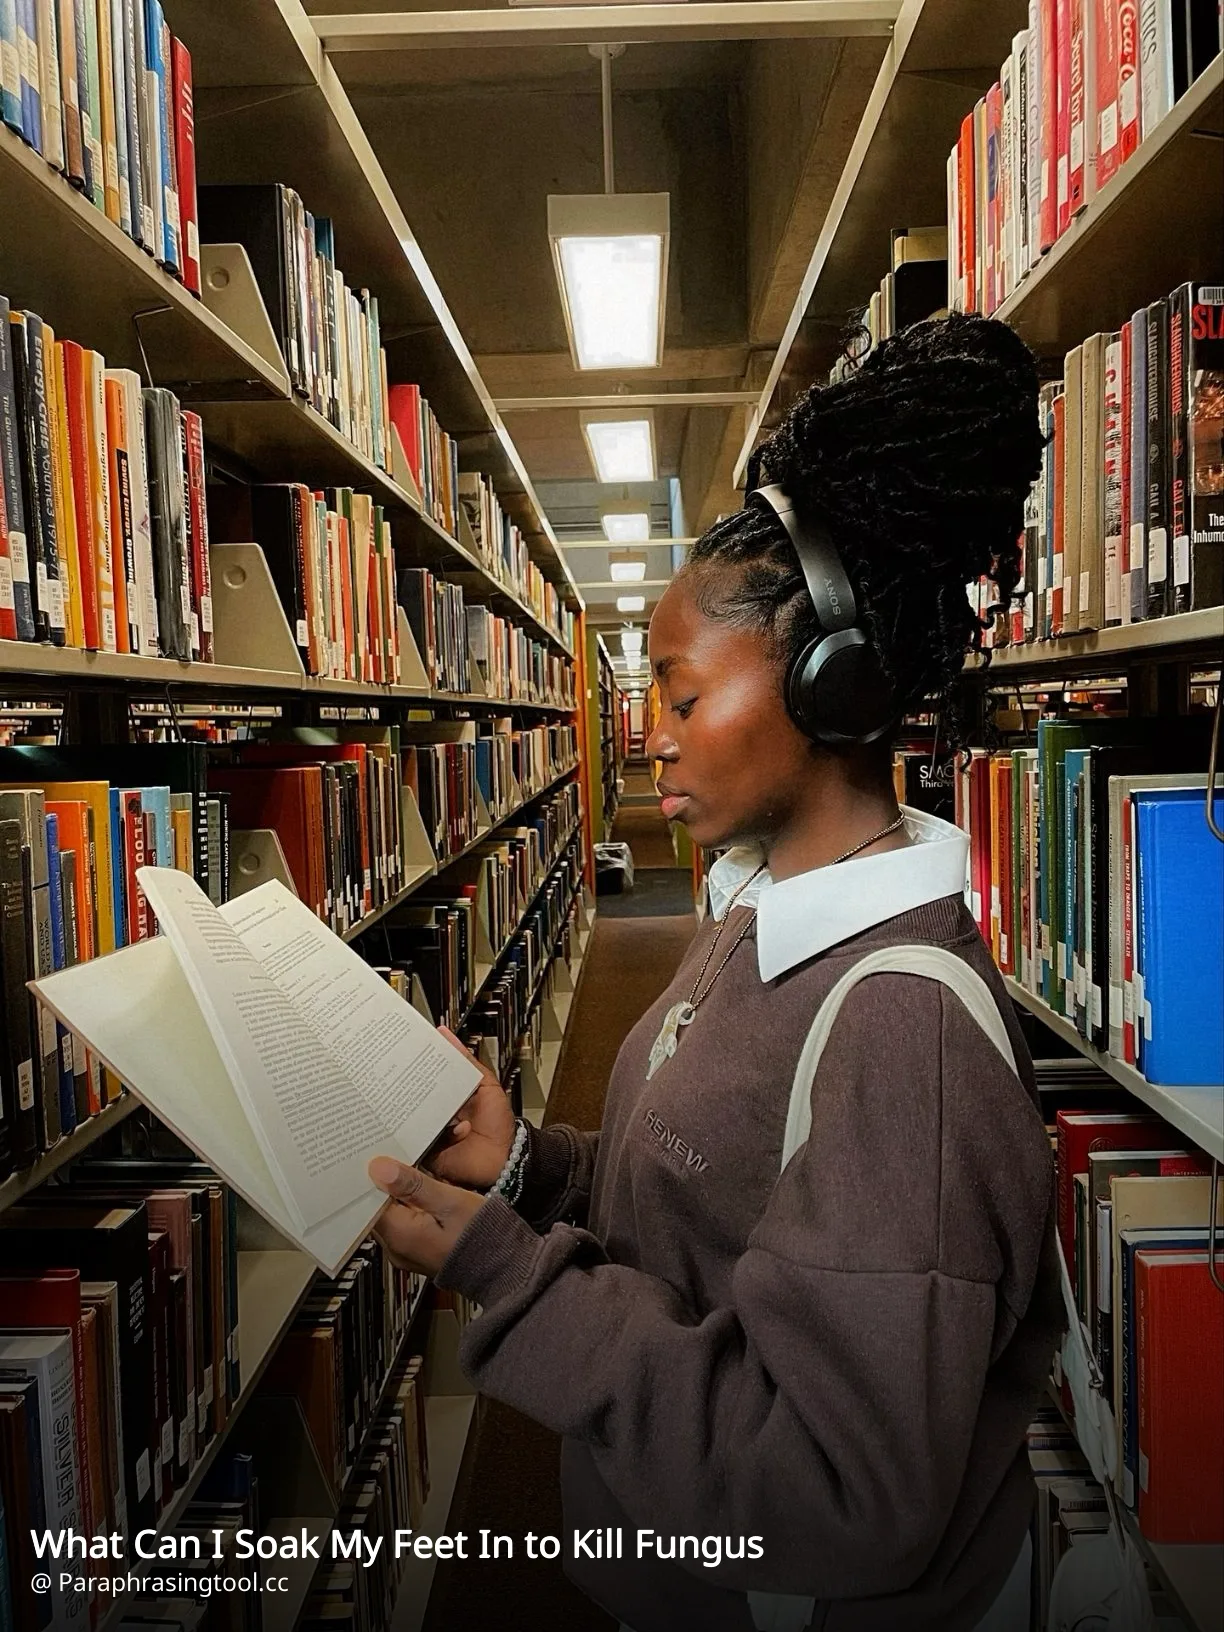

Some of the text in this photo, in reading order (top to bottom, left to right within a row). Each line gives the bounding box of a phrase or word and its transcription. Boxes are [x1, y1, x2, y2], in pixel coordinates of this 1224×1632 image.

[1071, 30, 1084, 84] Secret
[1148, 321, 1159, 423] SLAUGHTERHOUSE
[1171, 312, 1184, 415] SLAUGHTERHOUSE
[5, 416, 15, 477] Governance
[12, 492, 20, 528] Energy
[121, 458, 129, 497] Saving
[1149, 482, 1159, 507] GAIL
[1208, 513, 1224, 527] The
[48, 523, 60, 581] 1975-77
[823, 578, 842, 616] SONY
[53, 1413, 76, 1508] SILVER
